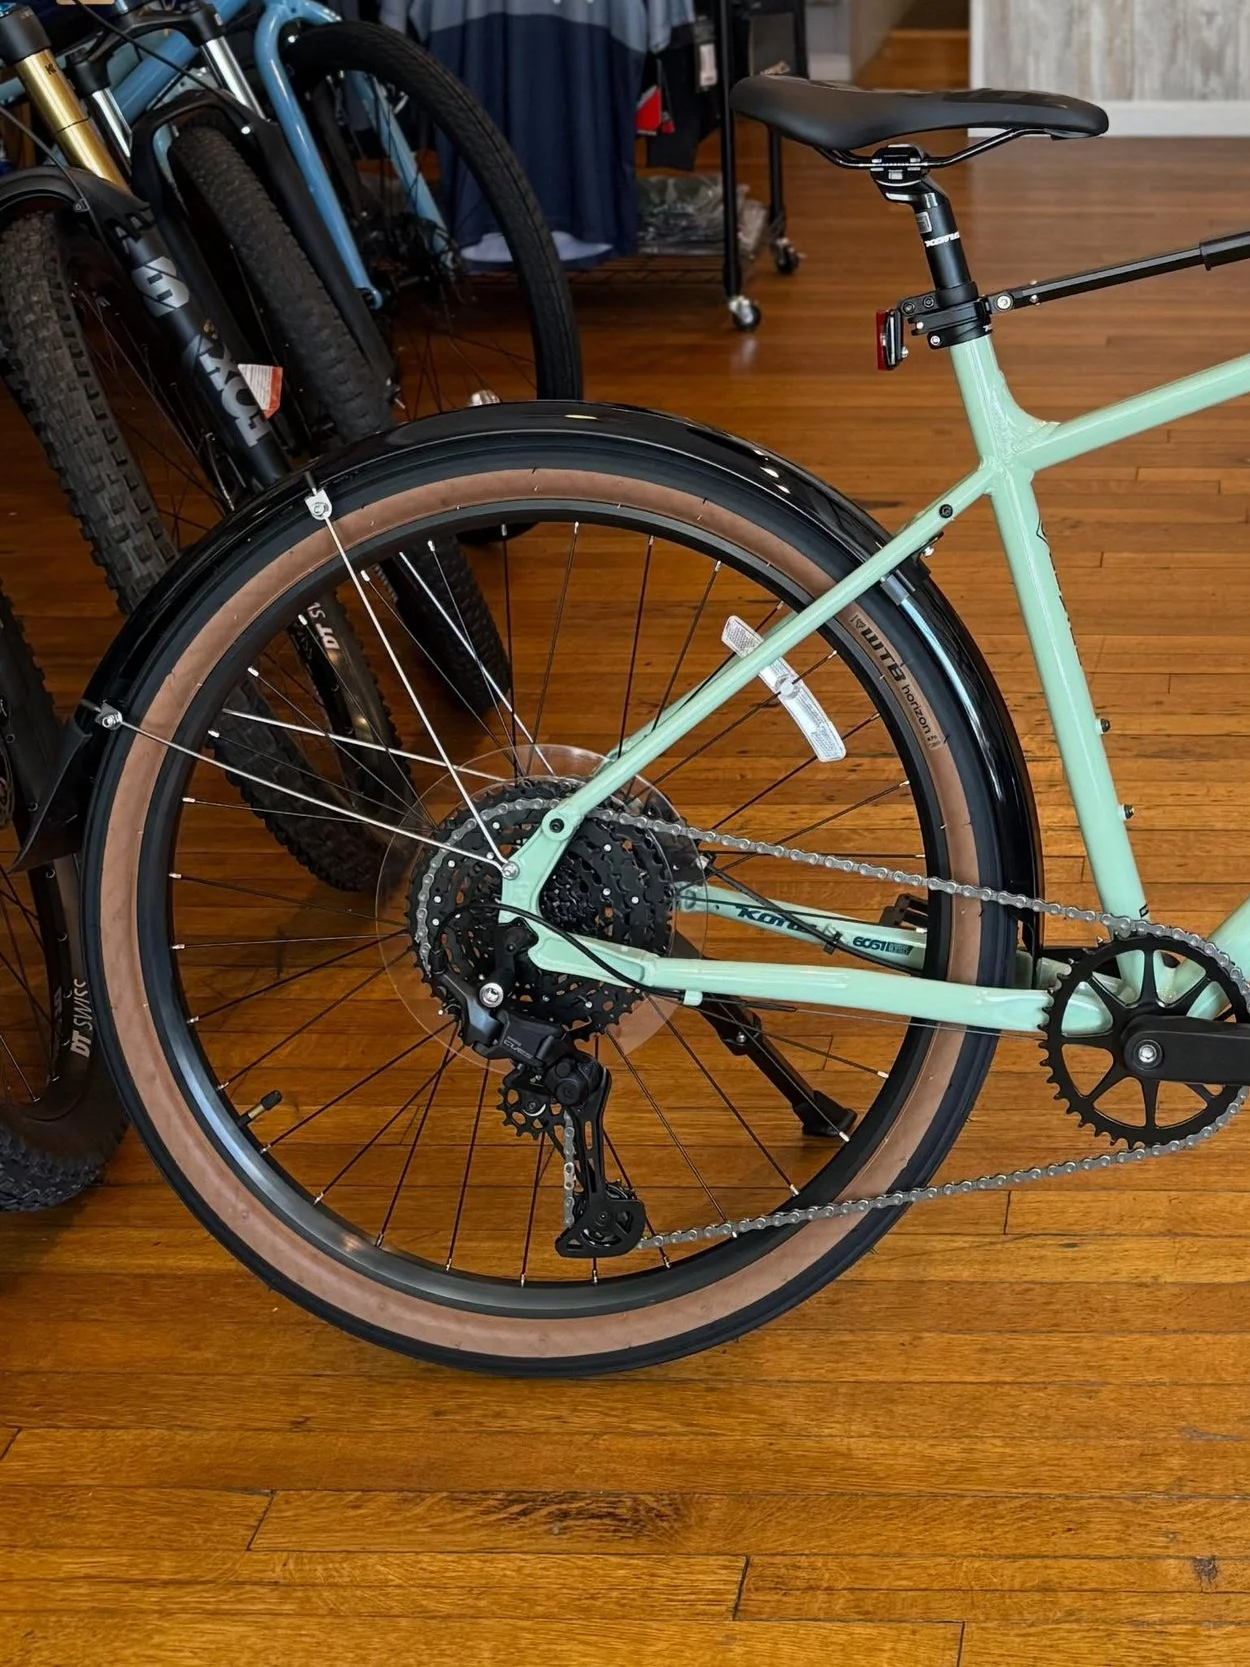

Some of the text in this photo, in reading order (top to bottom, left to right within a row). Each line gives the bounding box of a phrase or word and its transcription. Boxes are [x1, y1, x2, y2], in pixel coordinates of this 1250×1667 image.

[199, 342, 274, 449] FOX
[861, 628, 931, 734] WTB horizon
[70, 1029, 92, 1058] DT
